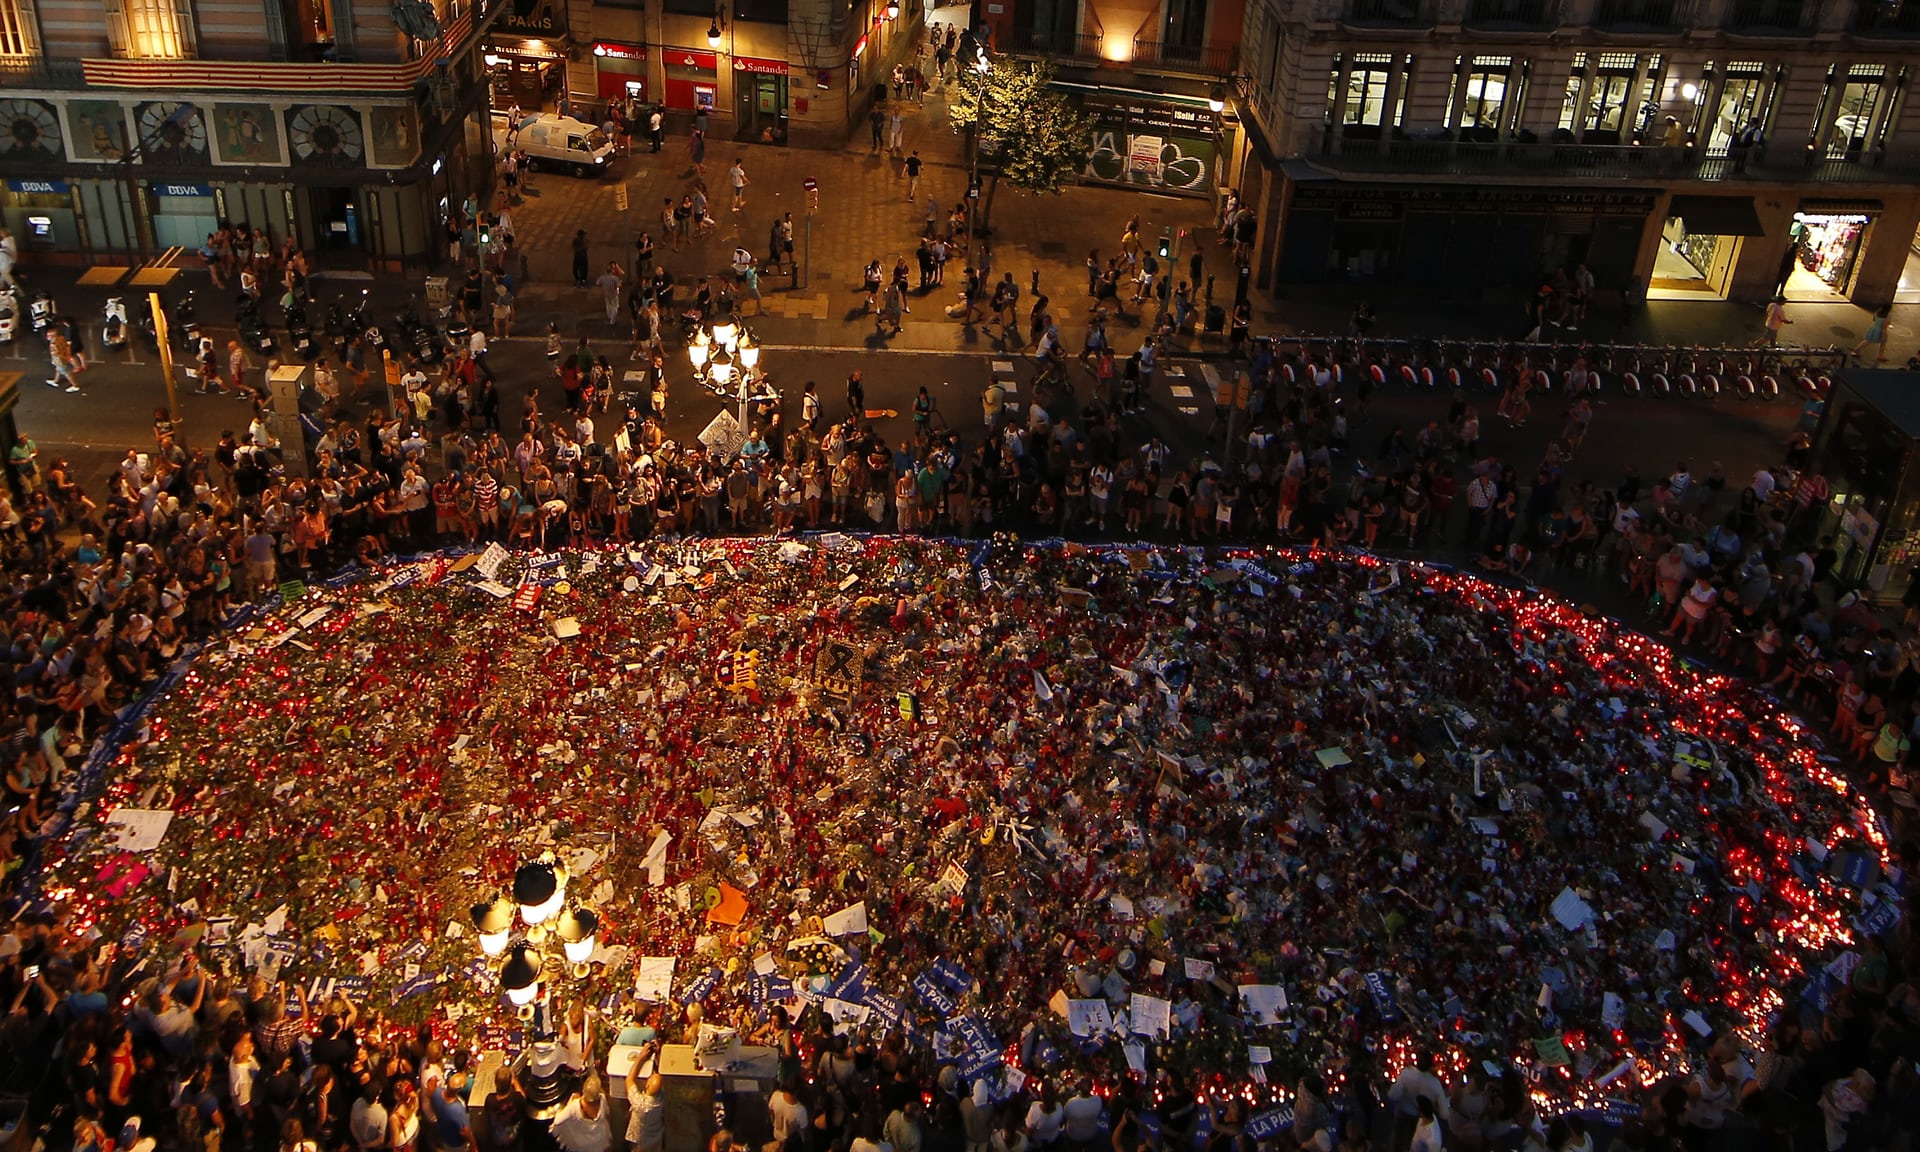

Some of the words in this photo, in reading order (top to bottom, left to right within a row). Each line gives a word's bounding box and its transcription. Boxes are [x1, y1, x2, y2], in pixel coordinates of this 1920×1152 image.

[508, 15, 552, 29] PARIS
[607, 48, 646, 60] Santander
[747, 63, 788, 75] Santander
[20, 182, 54, 192] BBVA
[167, 185, 199, 195] BBVA
[529, 555, 547, 566] PAU
[1247, 562, 1265, 576] PAU
[913, 975, 927, 993] LA
[926, 989, 950, 1012] PAU
[1252, 1120, 1272, 1136] LA
[1269, 1107, 1295, 1128] PAU
